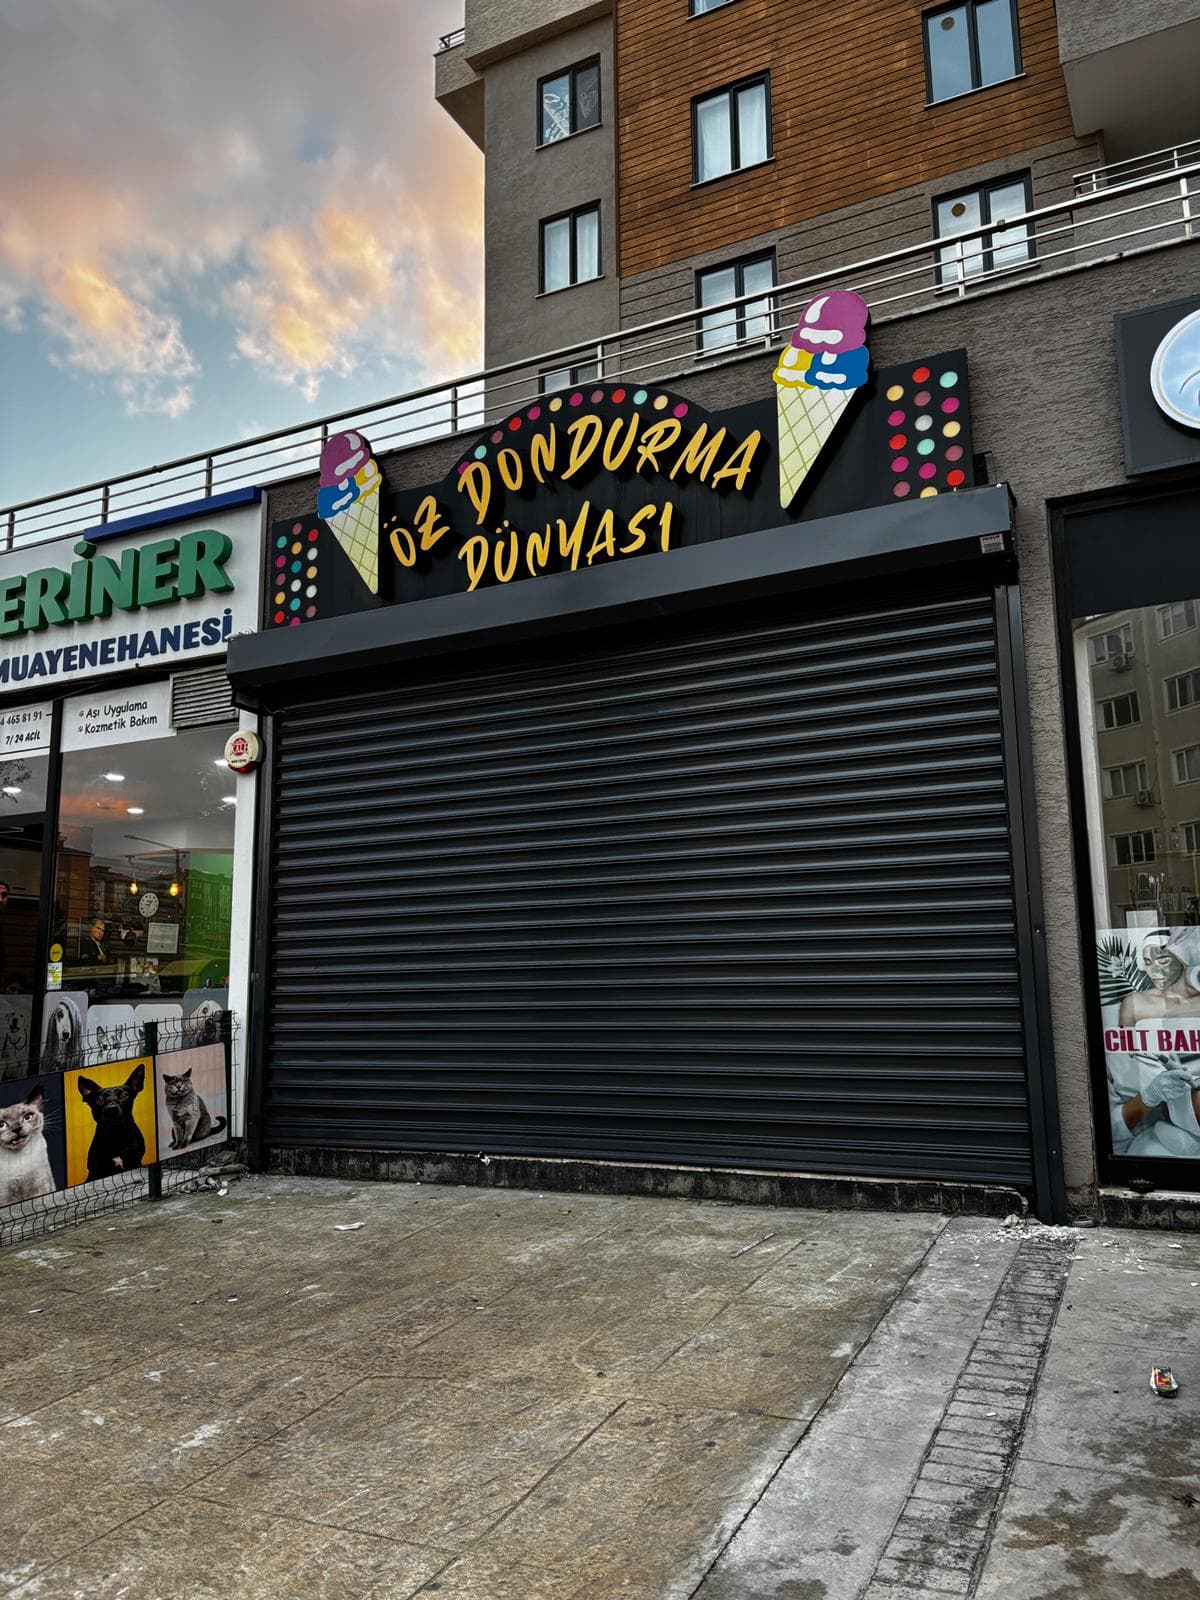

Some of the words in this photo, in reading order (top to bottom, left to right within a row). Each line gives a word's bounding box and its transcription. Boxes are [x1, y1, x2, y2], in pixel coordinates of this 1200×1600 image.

[457, 411, 762, 525] DONDURMA
[383, 495, 450, 568] ÖZ
[457, 500, 673, 592] DÜNYASI
[6, 714, 21, 725] 465
[22, 712, 31, 723] 81
[33, 710, 42, 721] 91
[86, 708, 100, 719] Aşı
[104, 701, 148, 718] Uygulama
[15, 733, 24, 743] 24
[25, 729, 41, 742] ACİL
[85, 718, 126, 735] Kozmetik
[130, 714, 158, 728] Bakım
[1104, 1024, 1149, 1052] CİLT
